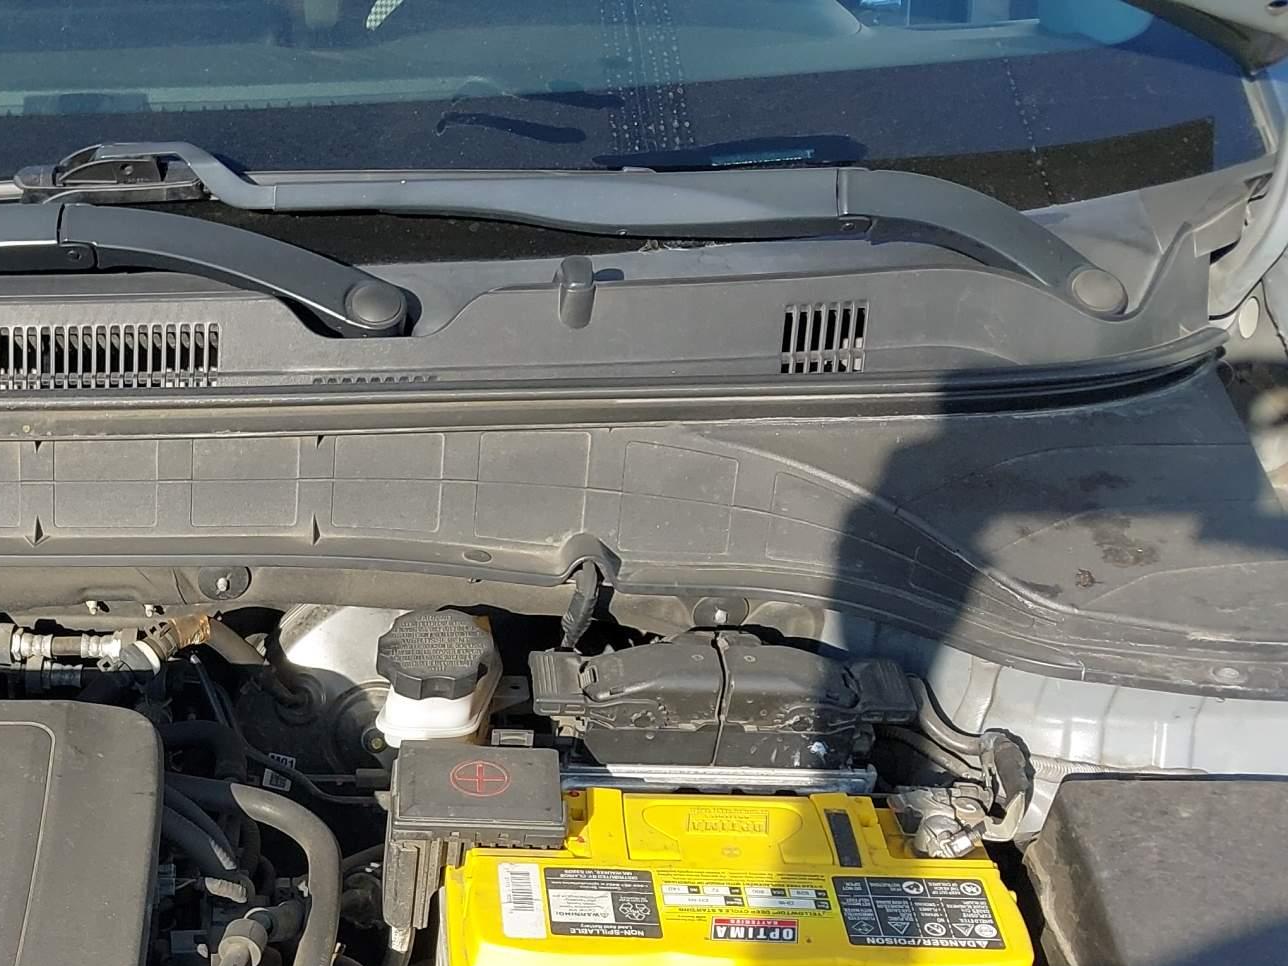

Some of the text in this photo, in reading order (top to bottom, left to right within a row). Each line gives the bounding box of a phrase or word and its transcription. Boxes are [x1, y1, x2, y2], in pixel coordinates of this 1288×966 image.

[570, 928, 645, 937] NON-SPILLABLE
[715, 926, 793, 940] OPTIMA
[866, 937, 976, 948] DANGER/POISON
